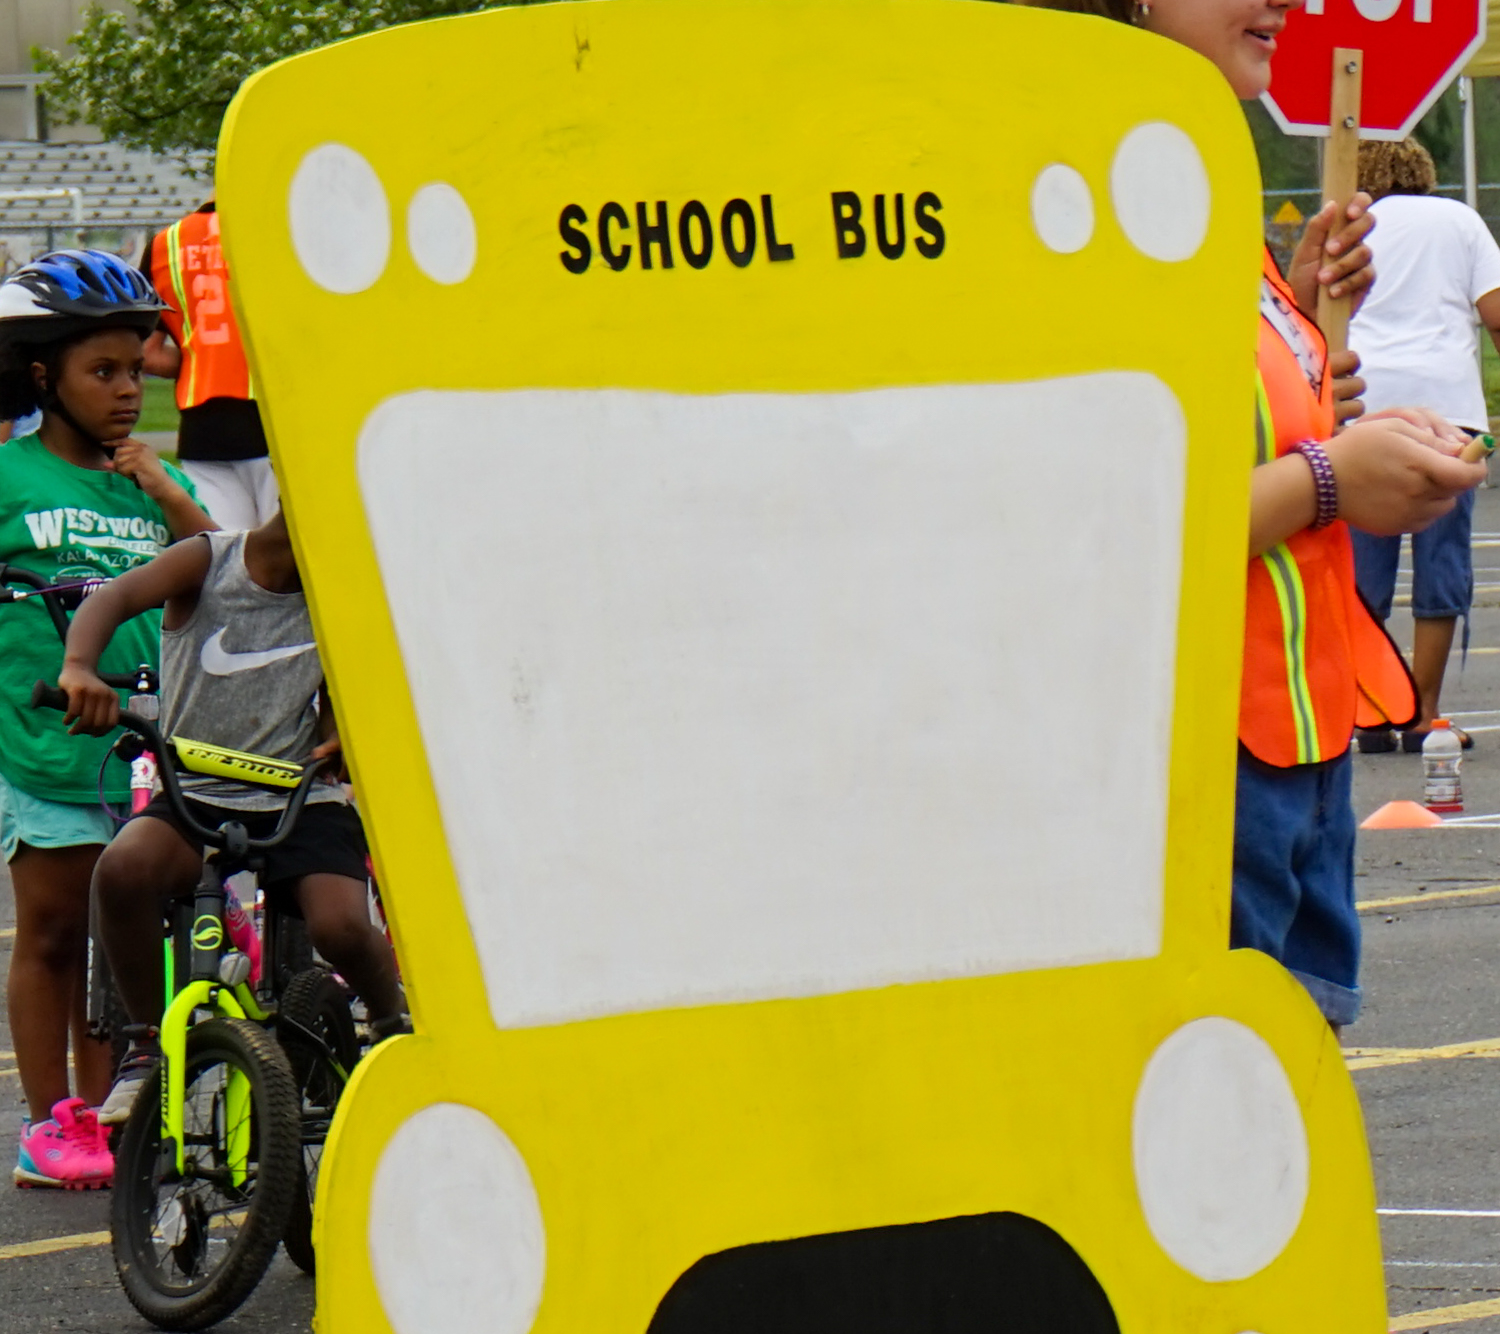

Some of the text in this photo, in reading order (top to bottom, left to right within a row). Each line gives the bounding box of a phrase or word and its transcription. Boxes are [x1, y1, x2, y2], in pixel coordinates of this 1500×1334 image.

[559, 191, 946, 274] SCHOOL BUS
[24, 507, 169, 551] WESTWOOD
[57, 548, 142, 568] KALAAZOO
